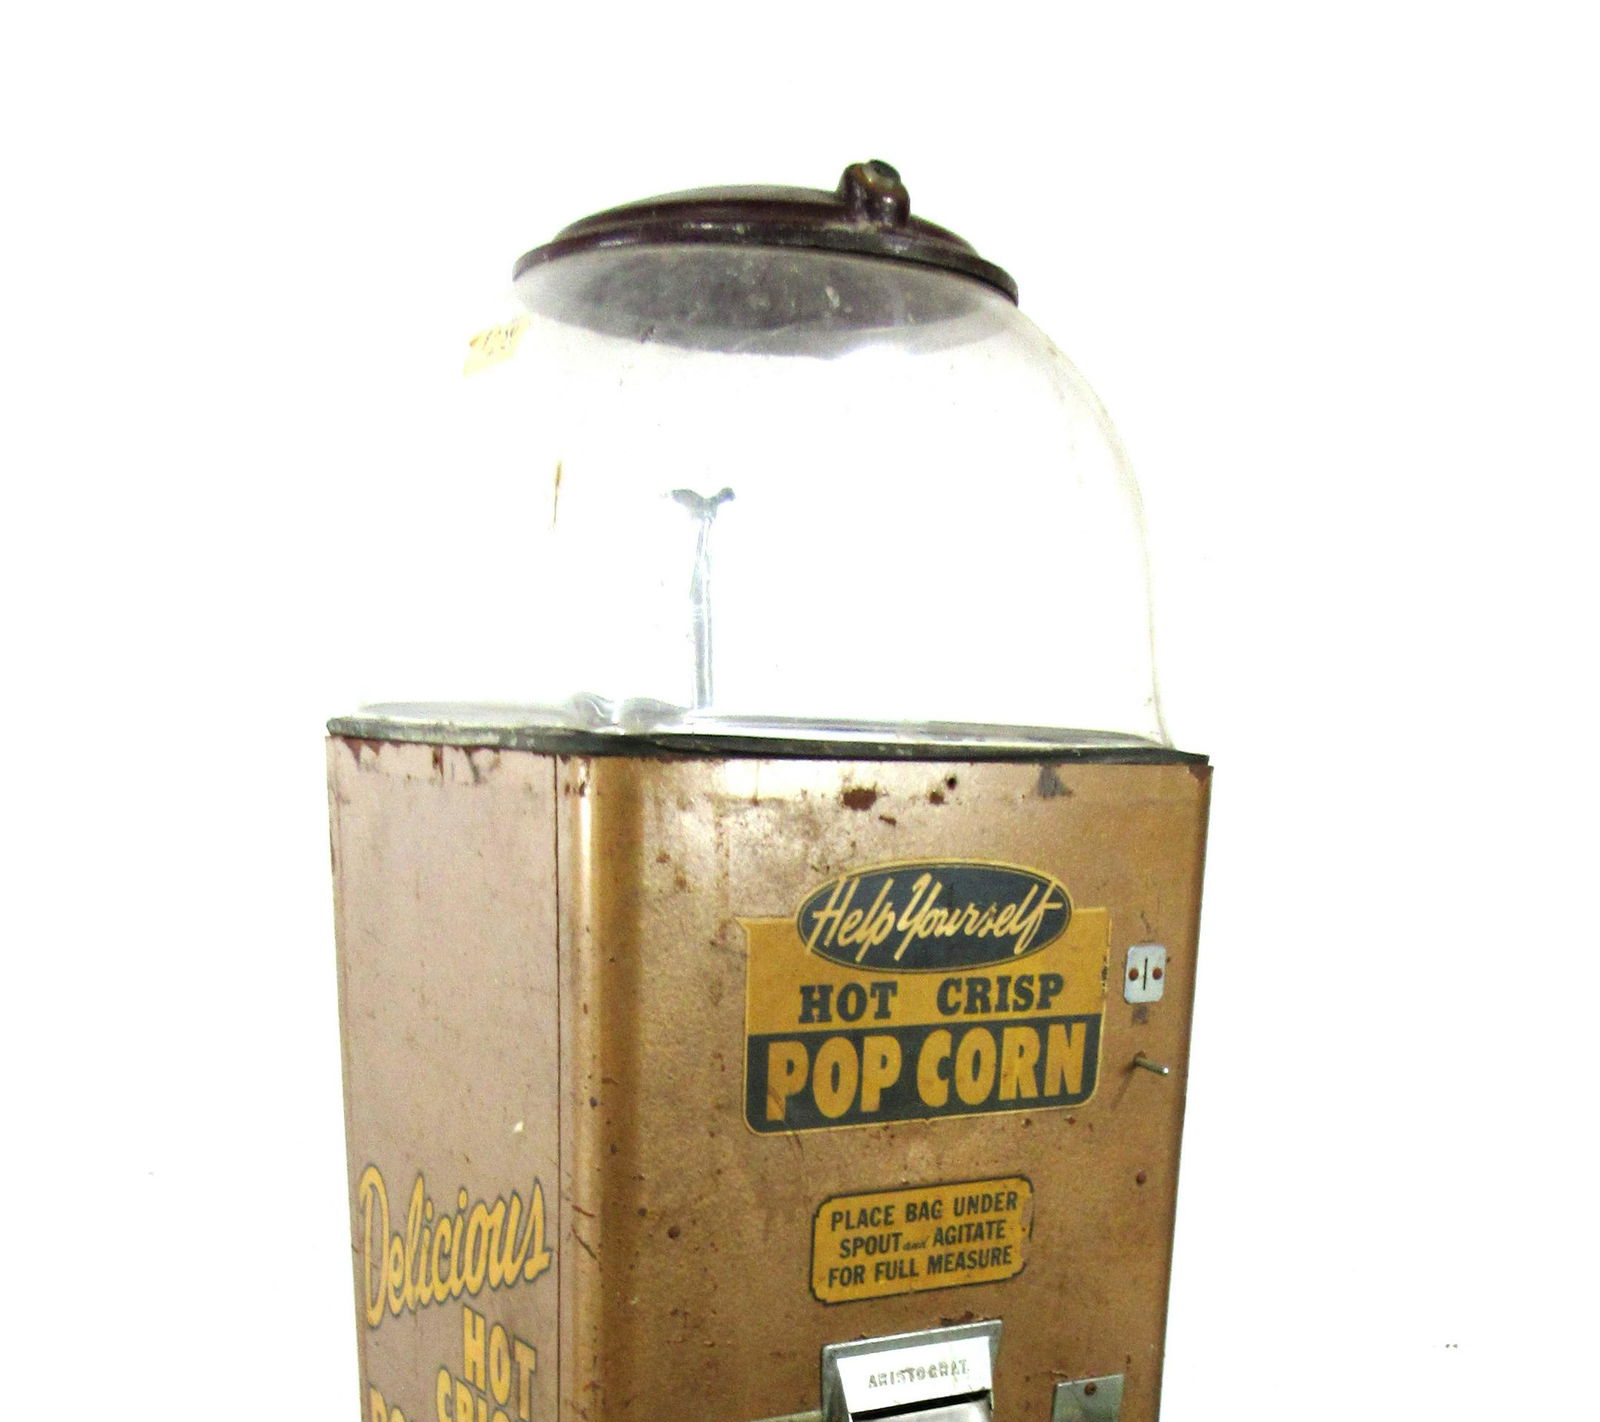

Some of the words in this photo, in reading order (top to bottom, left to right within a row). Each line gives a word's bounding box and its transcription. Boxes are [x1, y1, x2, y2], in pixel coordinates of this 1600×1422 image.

[806, 876, 896, 963] Help
[894, 873, 1063, 961] Yourself
[799, 981, 898, 1024] HOT
[937, 973, 1064, 1016] CRISP
[766, 1035, 902, 1121] POP
[917, 1022, 1087, 1107] CORN
[831, 1205, 895, 1232] PLACE
[905, 1200, 943, 1223] BAG
[953, 1191, 1018, 1217] UNDER
[358, 1163, 552, 1328] Delicious
[839, 1232, 902, 1259] SPOUT
[903, 1236, 929, 1251] and
[932, 1219, 1006, 1247] AGITATE
[828, 1264, 866, 1288] FOR
[874, 1258, 919, 1283] FULL
[927, 1245, 1013, 1275] MEASURE
[868, 1359, 968, 1388] ARISTOCRAT
